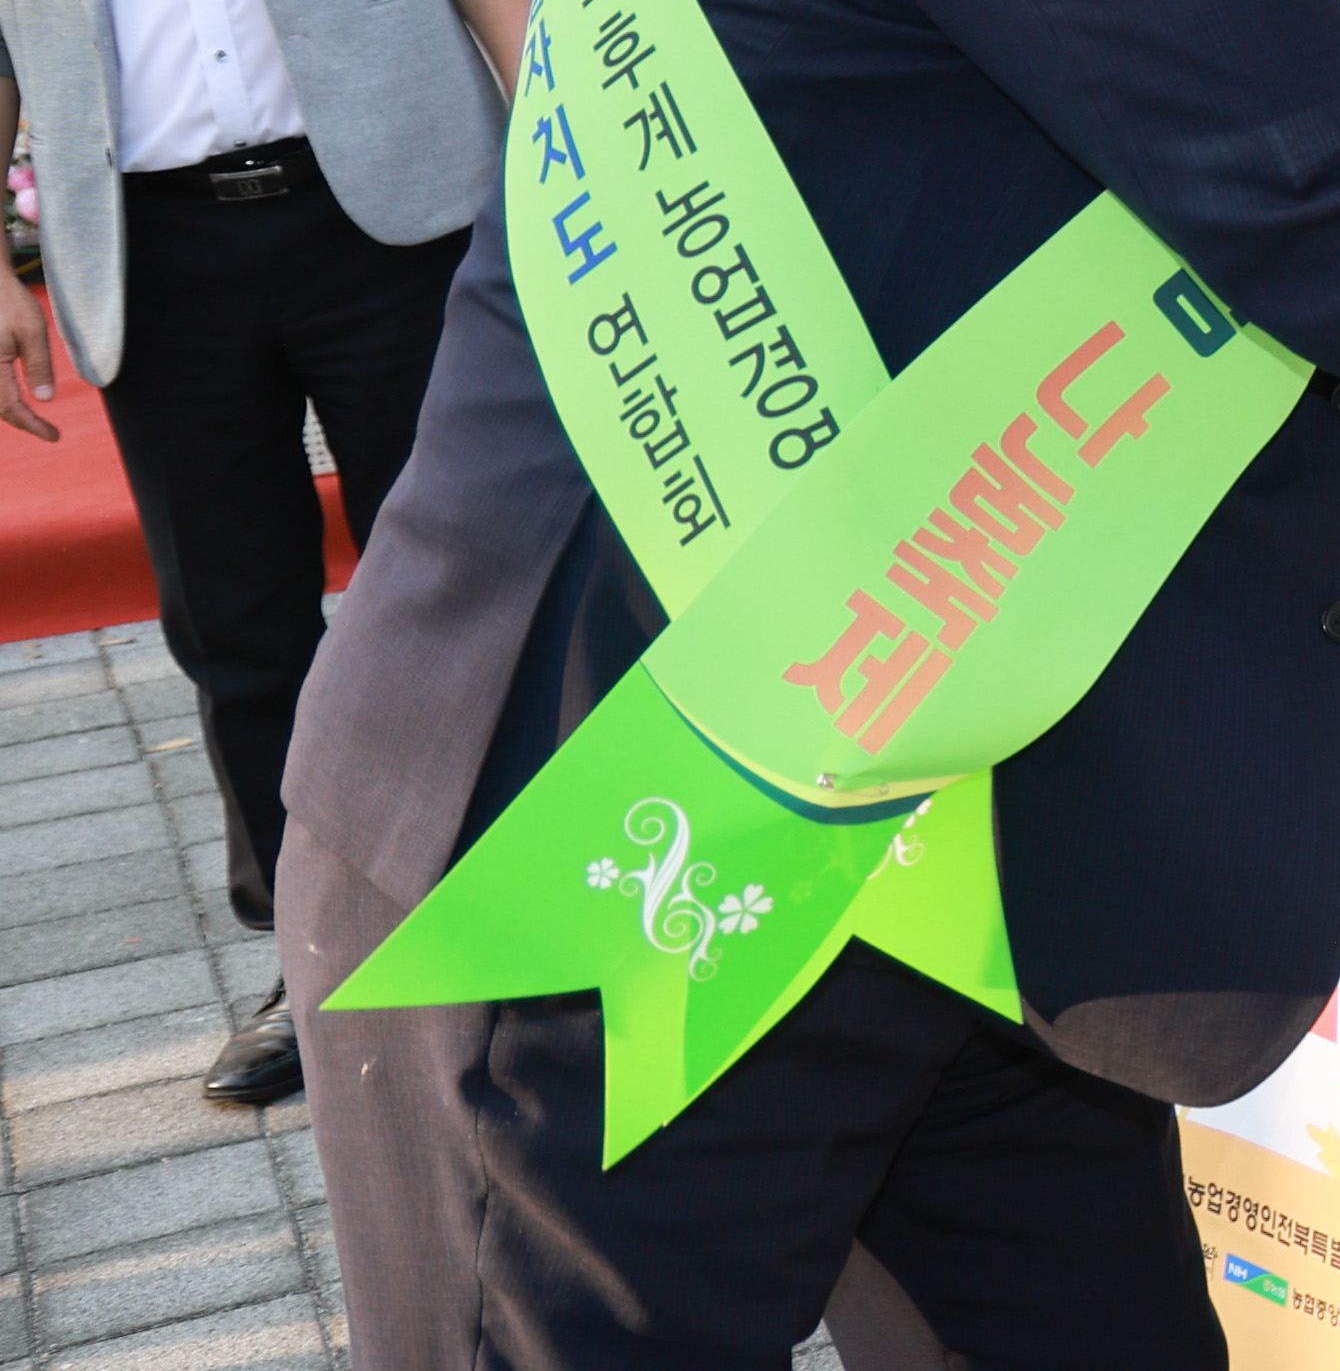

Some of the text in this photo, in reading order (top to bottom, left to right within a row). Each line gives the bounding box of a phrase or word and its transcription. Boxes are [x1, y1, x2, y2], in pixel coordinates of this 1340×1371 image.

[587, 293, 732, 548] 연합회
[780, 320, 1172, 757] 나눔축제
[1228, 1262, 1249, 1280] NH
